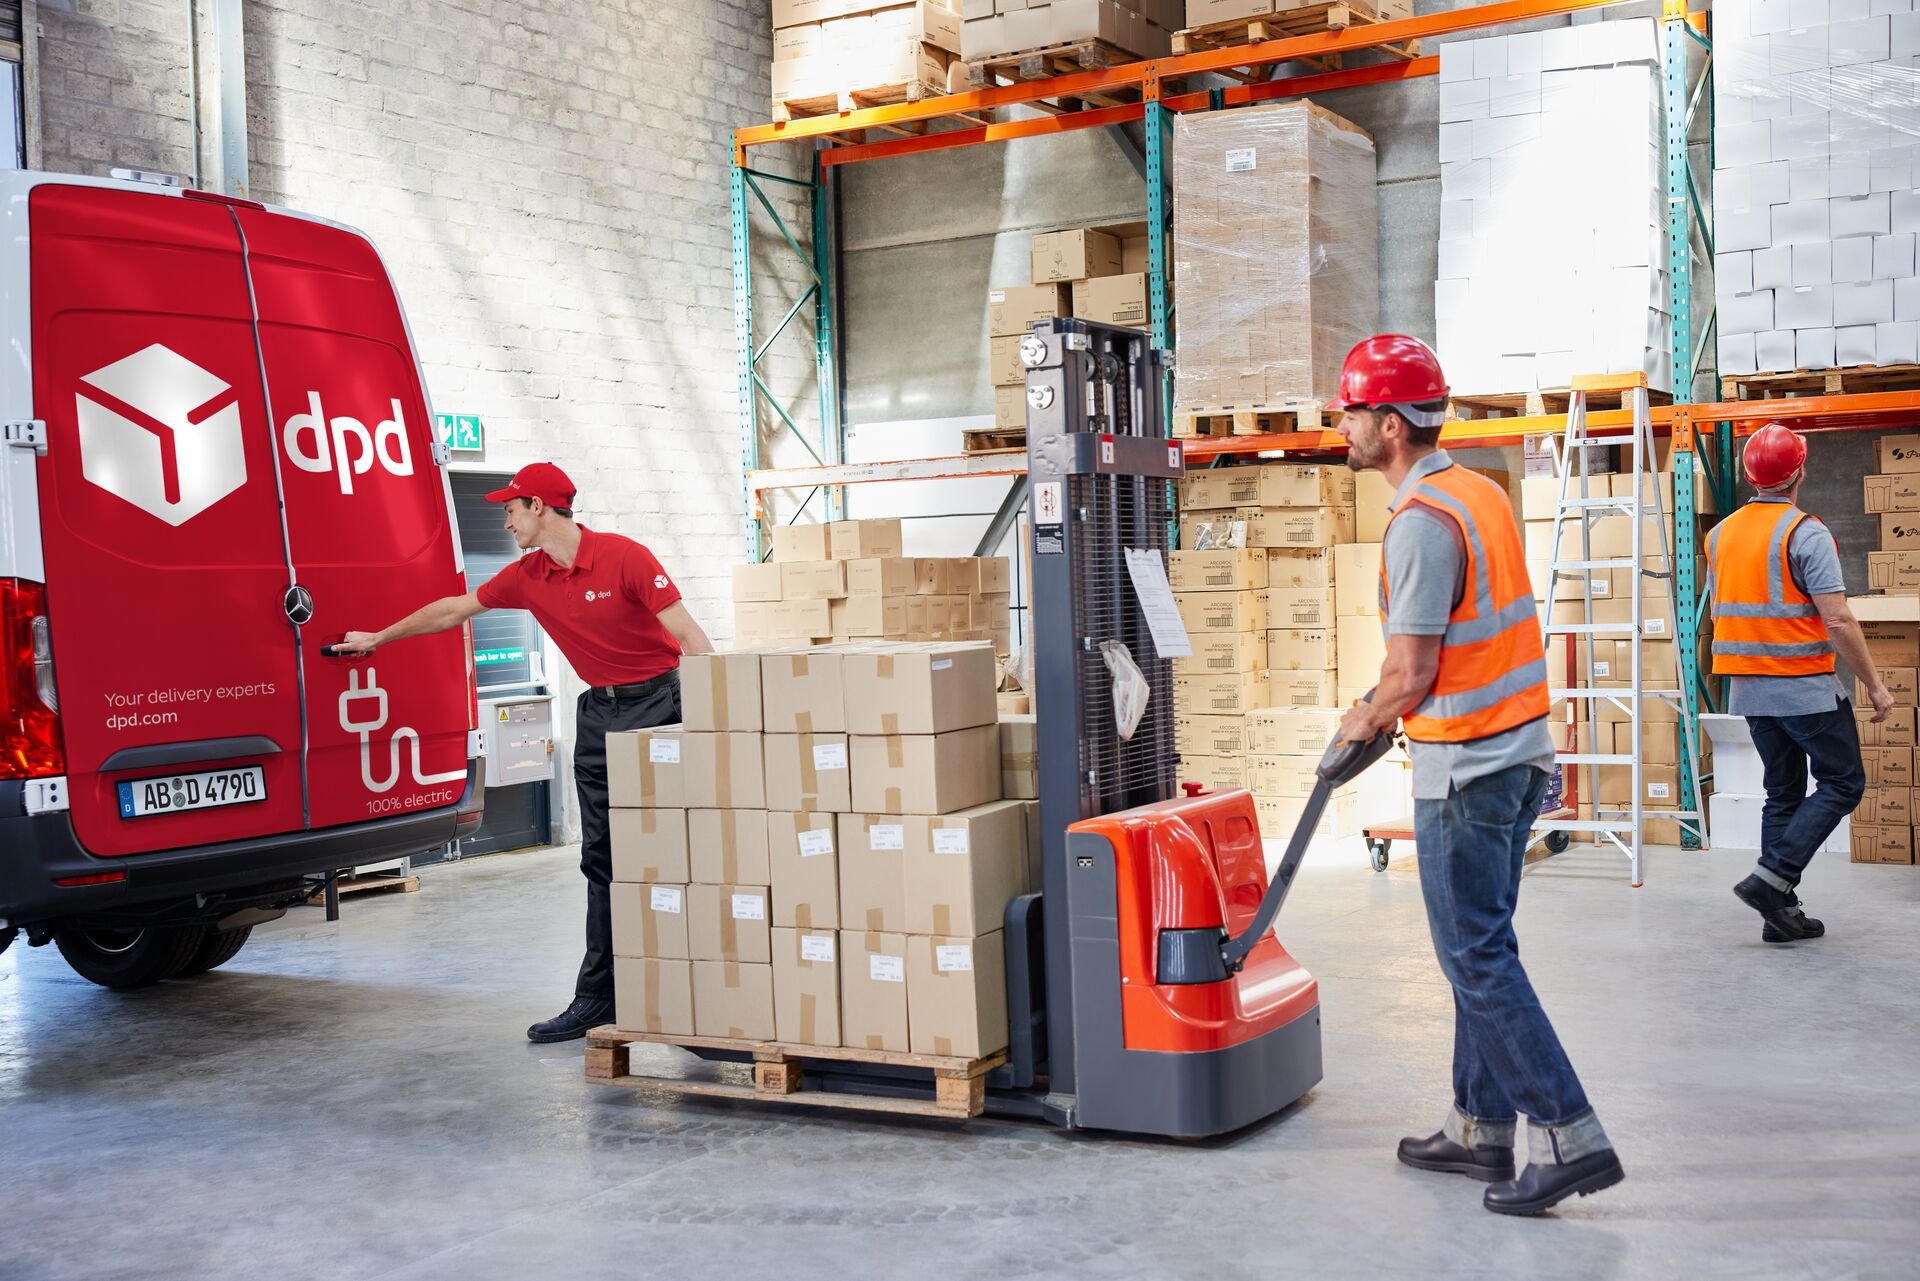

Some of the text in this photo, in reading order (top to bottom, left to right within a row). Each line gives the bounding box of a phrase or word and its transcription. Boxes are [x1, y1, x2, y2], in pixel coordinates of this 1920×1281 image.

[283, 390, 414, 495] dpd
[597, 590, 611, 599] dpd
[474, 651, 523, 662] ush bar to open
[105, 682, 276, 708] Your delivery experts
[106, 712, 178, 731] dpd.com
[144, 772, 257, 811] AB D 4790
[366, 788, 452, 814] 100% electric
[125, 804, 131, 813] D
